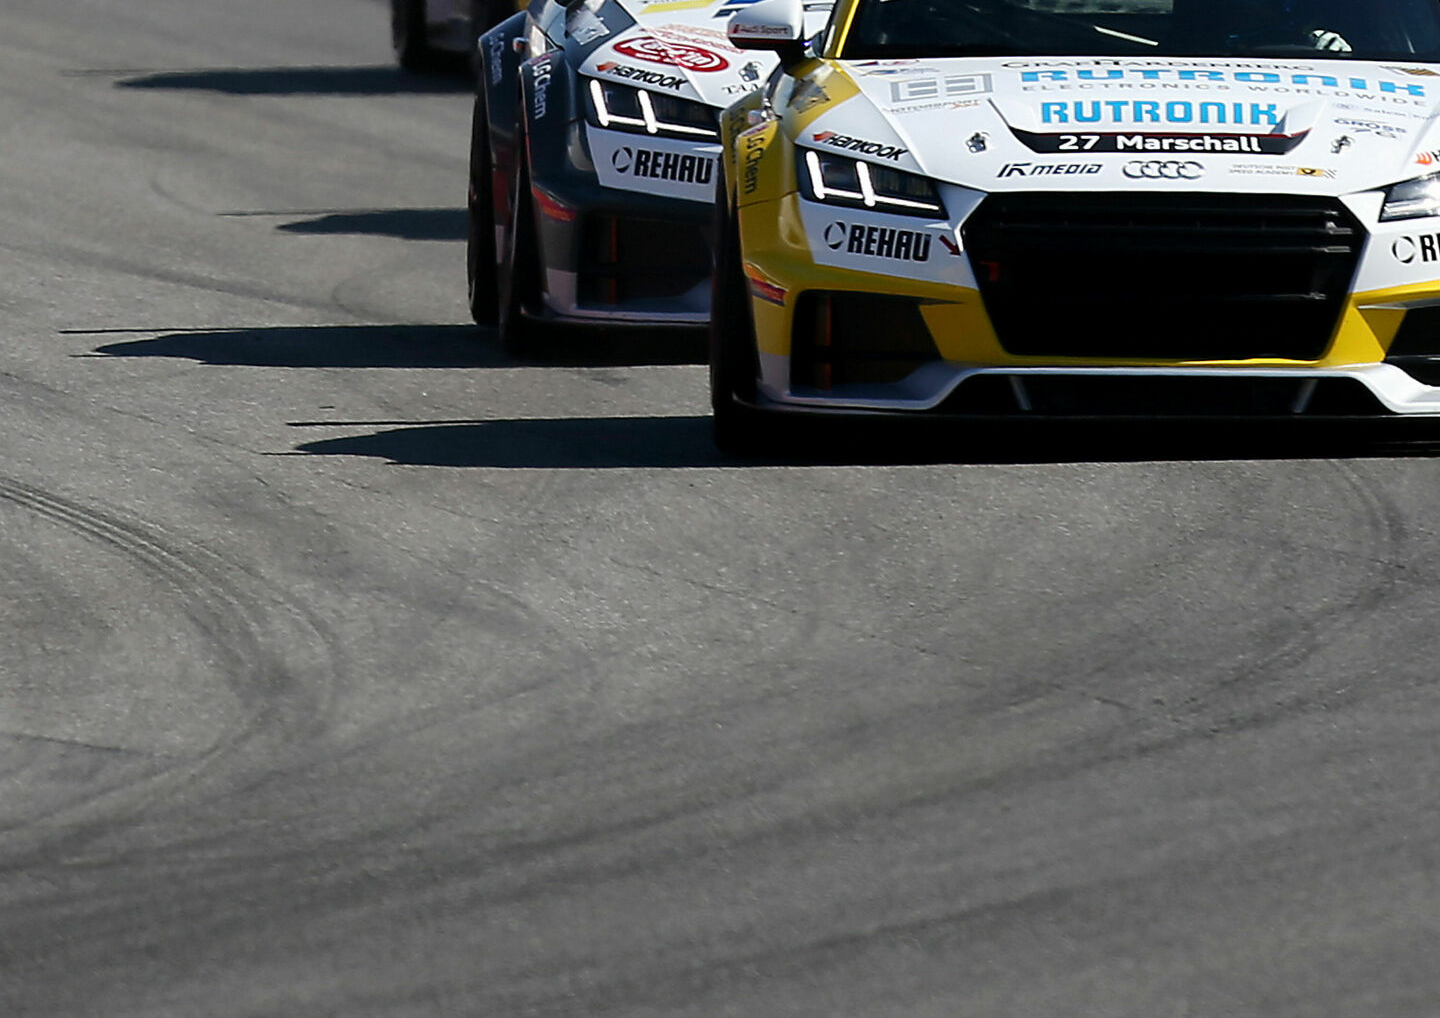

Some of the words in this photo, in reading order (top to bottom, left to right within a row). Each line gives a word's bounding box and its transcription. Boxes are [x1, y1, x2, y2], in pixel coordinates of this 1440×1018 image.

[1021, 68, 1425, 97] RUTRONIK
[1022, 83, 1230, 91] ELECTRONICS
[1248, 85, 1428, 107] WORLDWIDE
[1041, 100, 1279, 125] RUTRONIK
[1058, 134, 1101, 151] 27
[1116, 134, 1262, 153] Marschall
[633, 150, 714, 184] REHAU
[847, 223, 932, 262] REHAU
